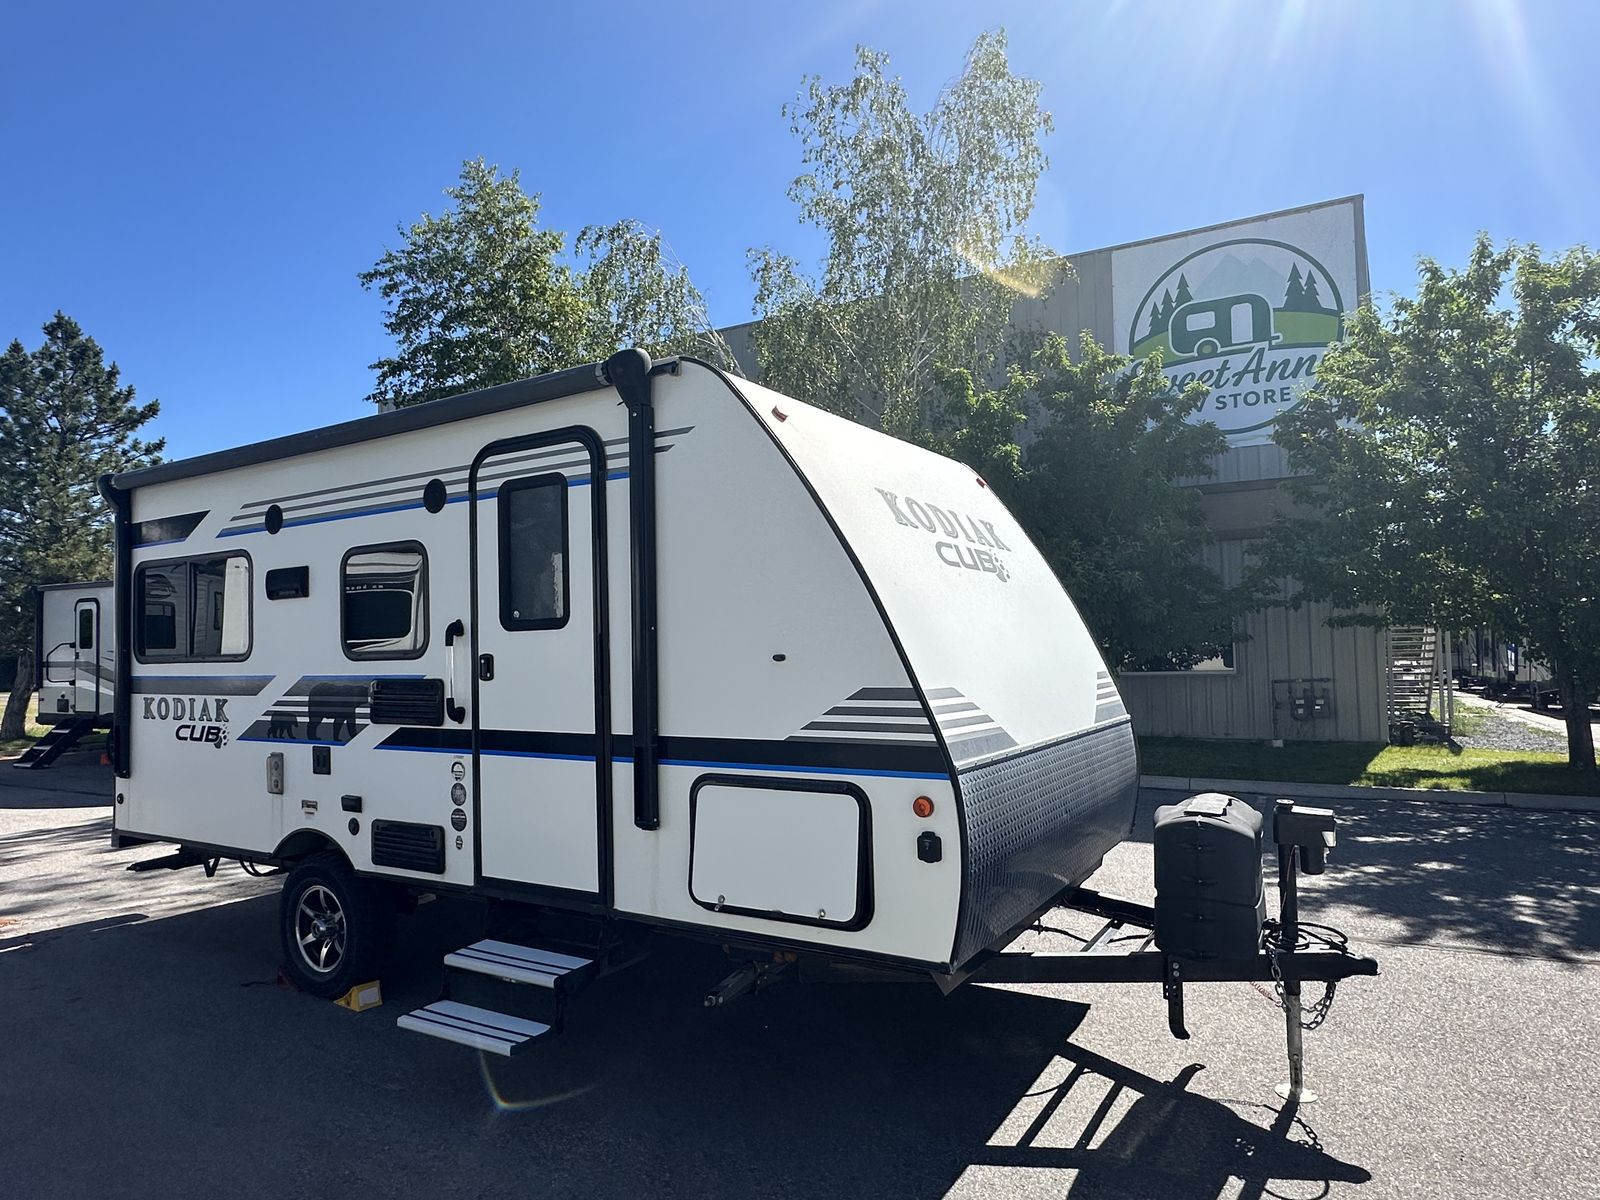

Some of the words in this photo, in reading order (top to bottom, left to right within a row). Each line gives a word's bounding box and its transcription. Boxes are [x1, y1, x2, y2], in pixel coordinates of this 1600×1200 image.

[1215, 386, 1292, 410] STORE
[874, 487, 1012, 552] KODIAK
[935, 541, 998, 574] CUB
[143, 697, 229, 722] KODIAK
[175, 724, 222, 742] CUB
